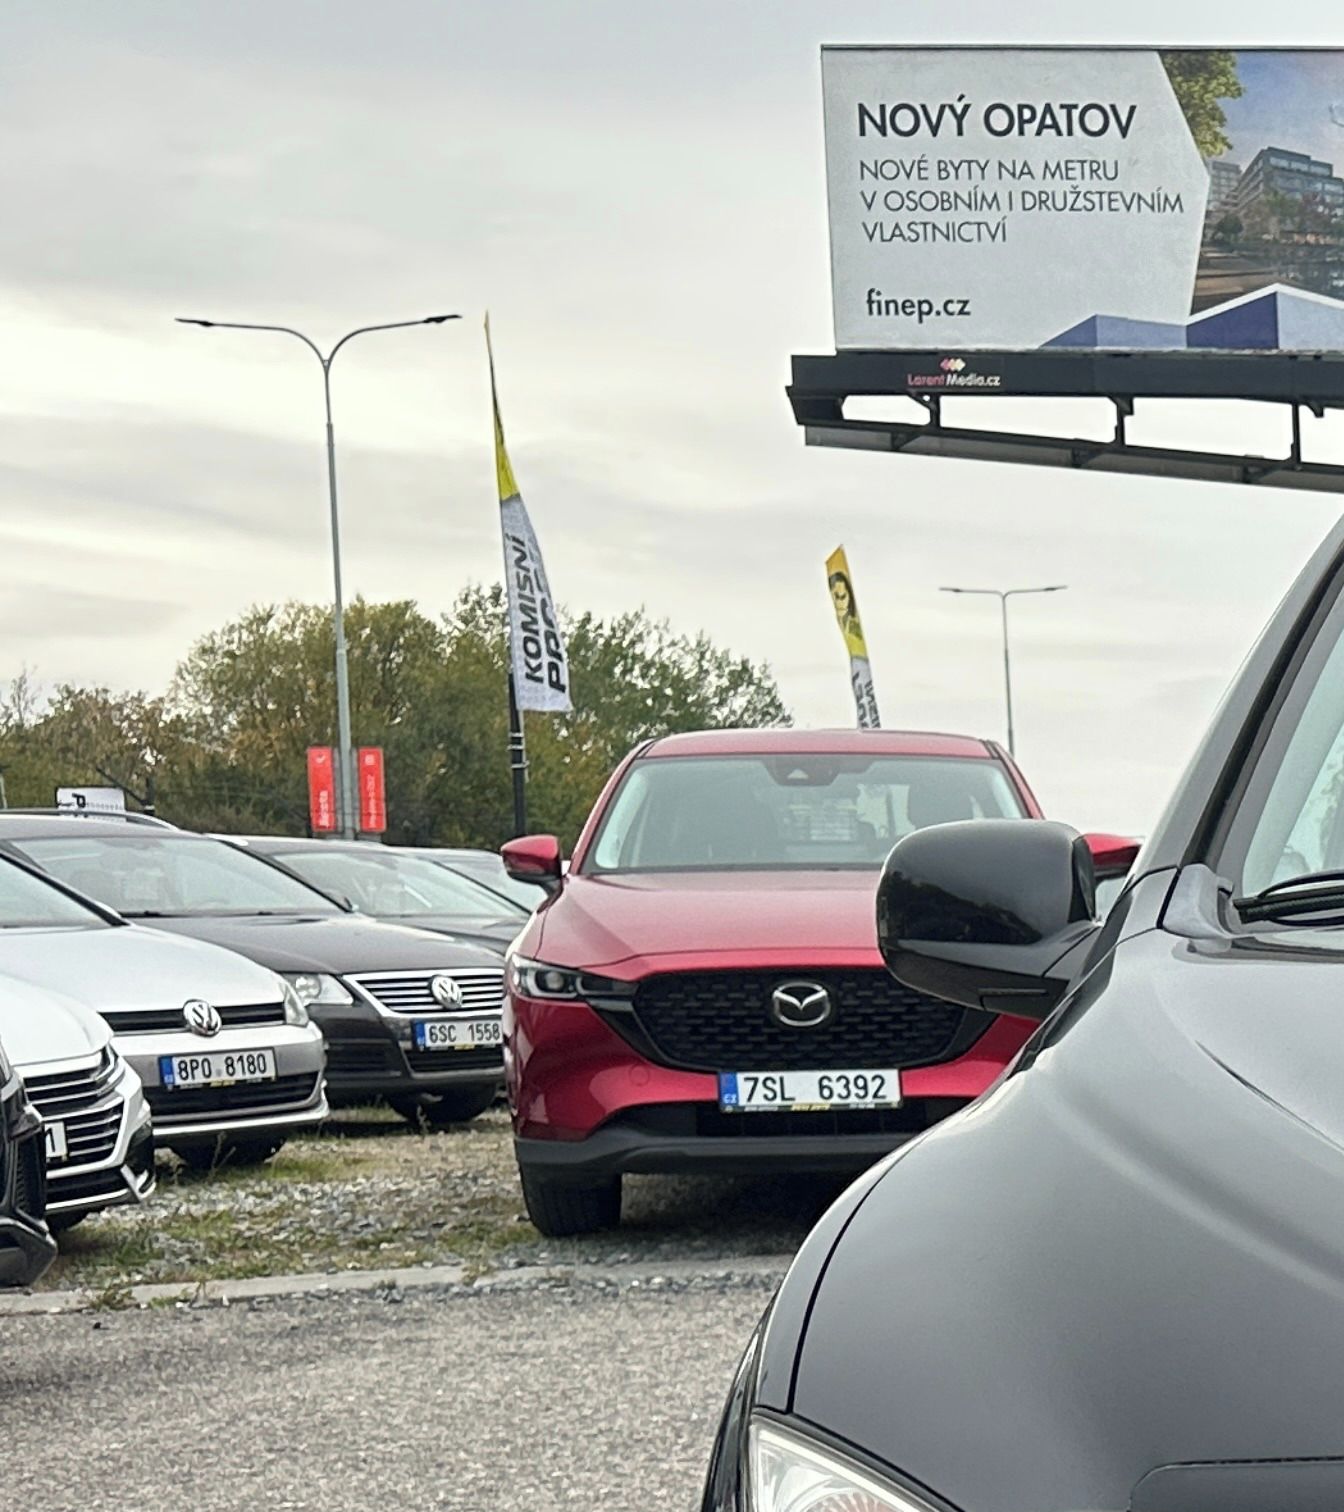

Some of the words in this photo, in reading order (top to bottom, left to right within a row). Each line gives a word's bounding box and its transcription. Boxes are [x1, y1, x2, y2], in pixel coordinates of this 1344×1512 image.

[858, 95, 972, 138] NOVÝ
[983, 102, 1137, 139] OPATOV
[859, 154, 929, 181] NOVÉ
[937, 159, 990, 181] BYTY
[998, 159, 1035, 181] NA
[1042, 159, 1119, 181] METRU
[860, 190, 877, 212] V
[884, 184, 1000, 212] OSOBNÍM
[1008, 190, 1013, 212] I
[1021, 184, 1184, 213] DRUŽSTEVNÍM
[862, 215, 1008, 243] VLASTNICTVÍ
[866, 288, 971, 324] finep.cz
[505, 532, 545, 685] KOMISNÍ
[429, 1024, 457, 1044] 6SC
[468, 1022, 500, 1042] 1558
[224, 1053, 267, 1077] 8180
[744, 1076, 796, 1103] 7SL
[818, 1074, 887, 1100] 6392
